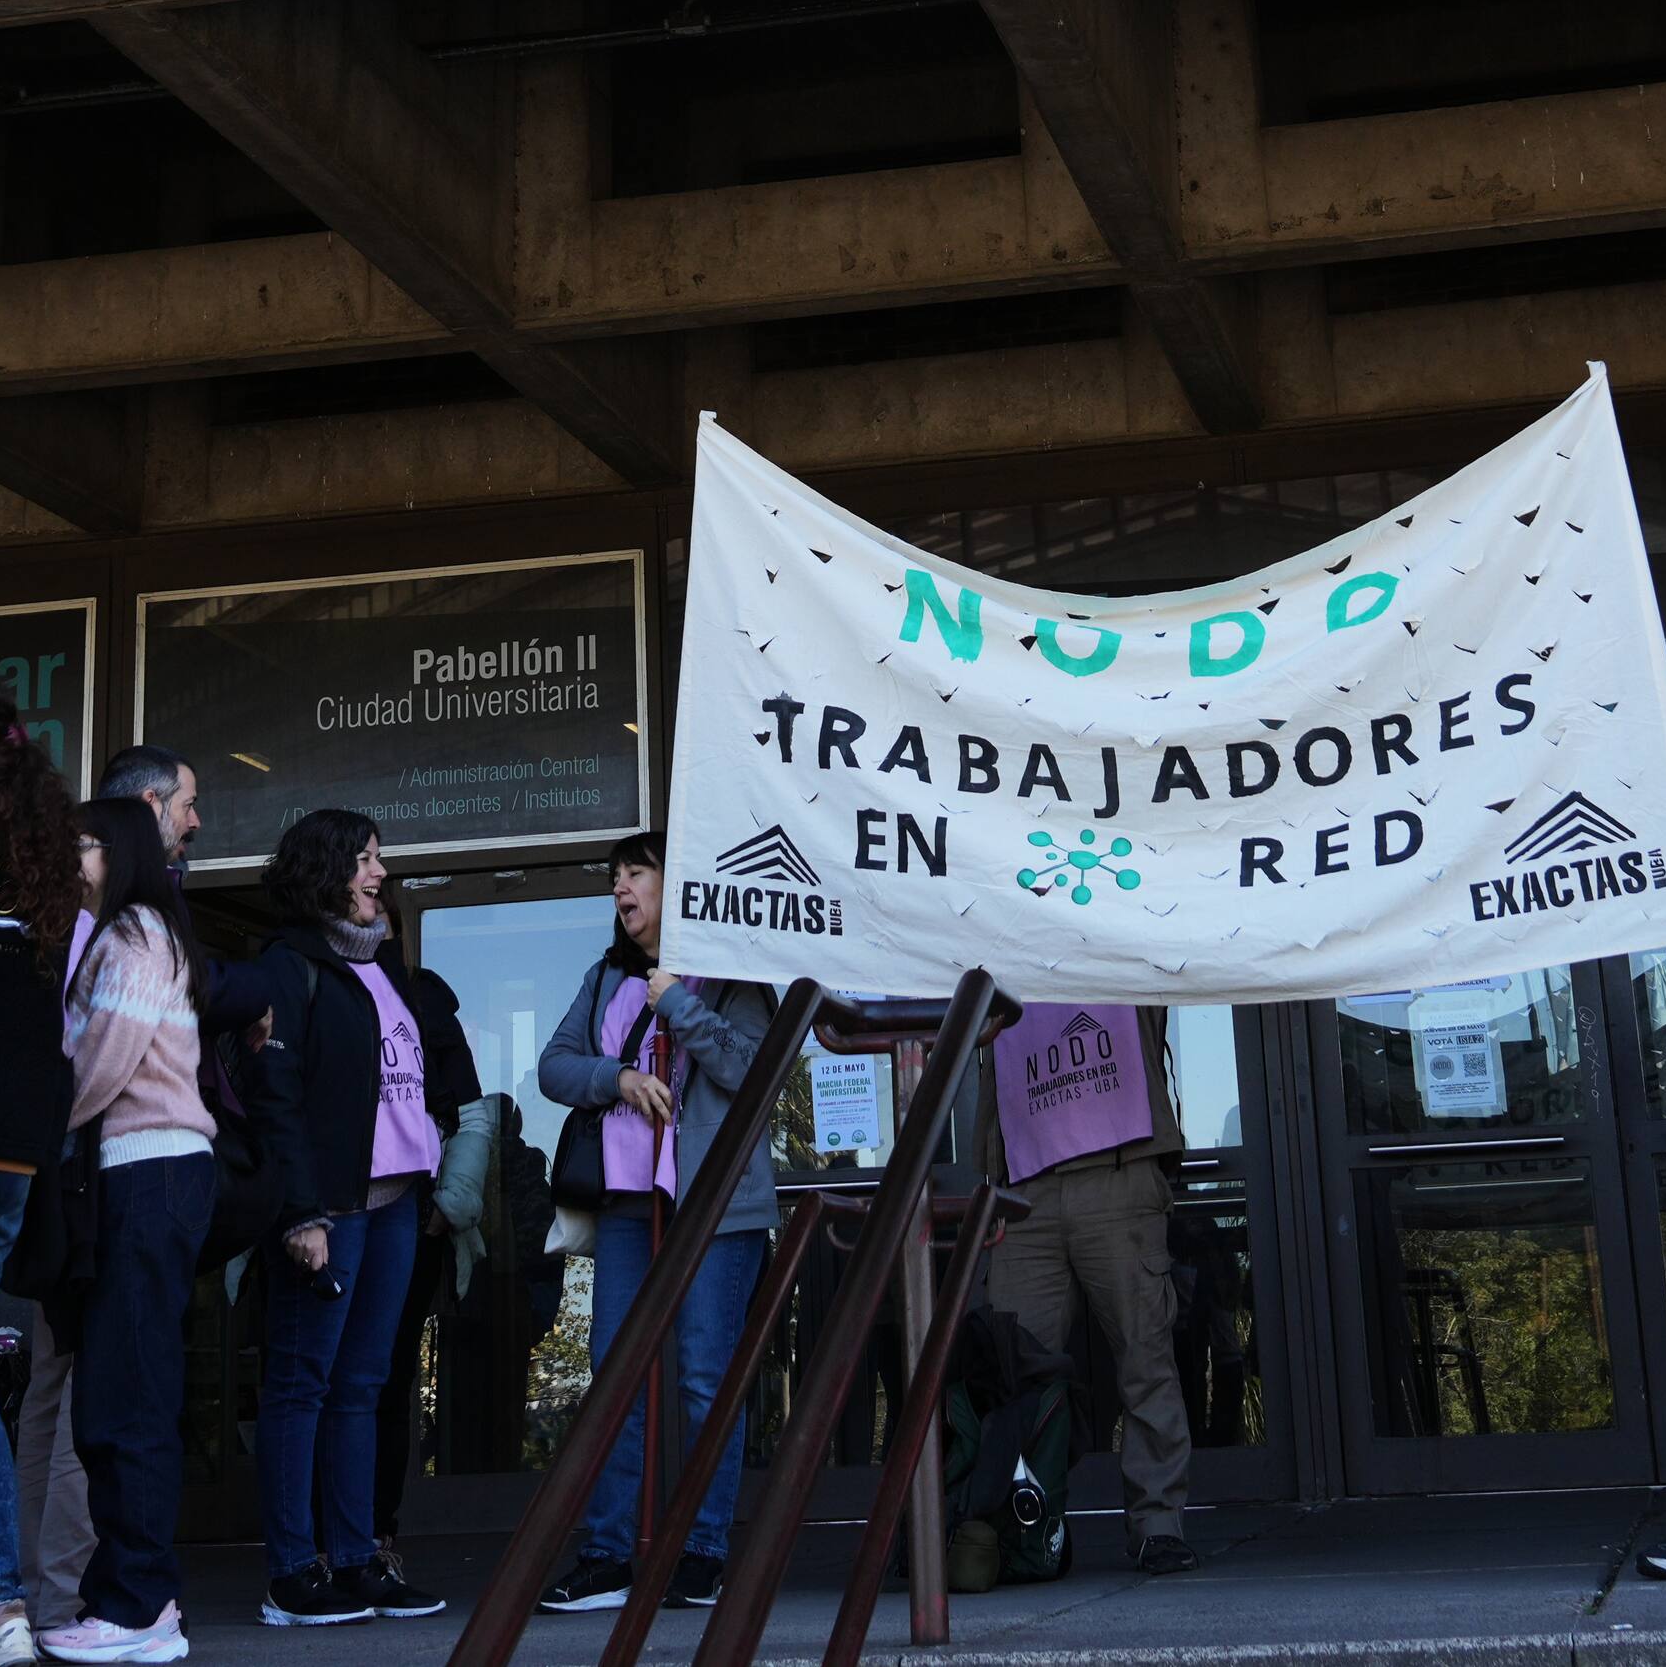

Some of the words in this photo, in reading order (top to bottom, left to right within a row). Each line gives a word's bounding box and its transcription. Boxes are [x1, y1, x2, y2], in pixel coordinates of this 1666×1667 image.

[413, 638, 563, 685] Pabellón
[576, 634, 598, 671] II
[316, 689, 413, 731] Ciudad
[423, 675, 600, 724] Universitaria
[761, 673, 1537, 819] TRABAJADORES
[410, 760, 534, 788] Administración
[540, 753, 600, 778] Central
[425, 793, 502, 817] docentes
[524, 785, 601, 810] Institutos
[854, 808, 949, 878] EN
[1239, 810, 1425, 888] RED
[1469, 851, 1648, 922] EXACTAS
[681, 880, 826, 935] EXACTAS
[1427, 1036, 1453, 1046] VOTÁ
[1467, 1023, 1486, 1031] MAYO
[821, 1065, 830, 1075] 12
[832, 1064, 842, 1074] DE
[844, 1062, 866, 1073] MAYO
[1026, 1029, 1113, 1084] NODO
[1433, 1061, 1452, 1071] NODO
[816, 1079, 843, 1089] MARCHA
[844, 1077, 871, 1087] FEDERAL
[819, 1087, 868, 1098] UNIVERSITARIA
[1027, 1070, 1085, 1100] TRABAJADORES
[1086, 1067, 1099, 1081] EN
[1100, 1062, 1118, 1076] RED
[1028, 1085, 1082, 1116] EXACTAS
[1094, 1076, 1121, 1095] UBA
